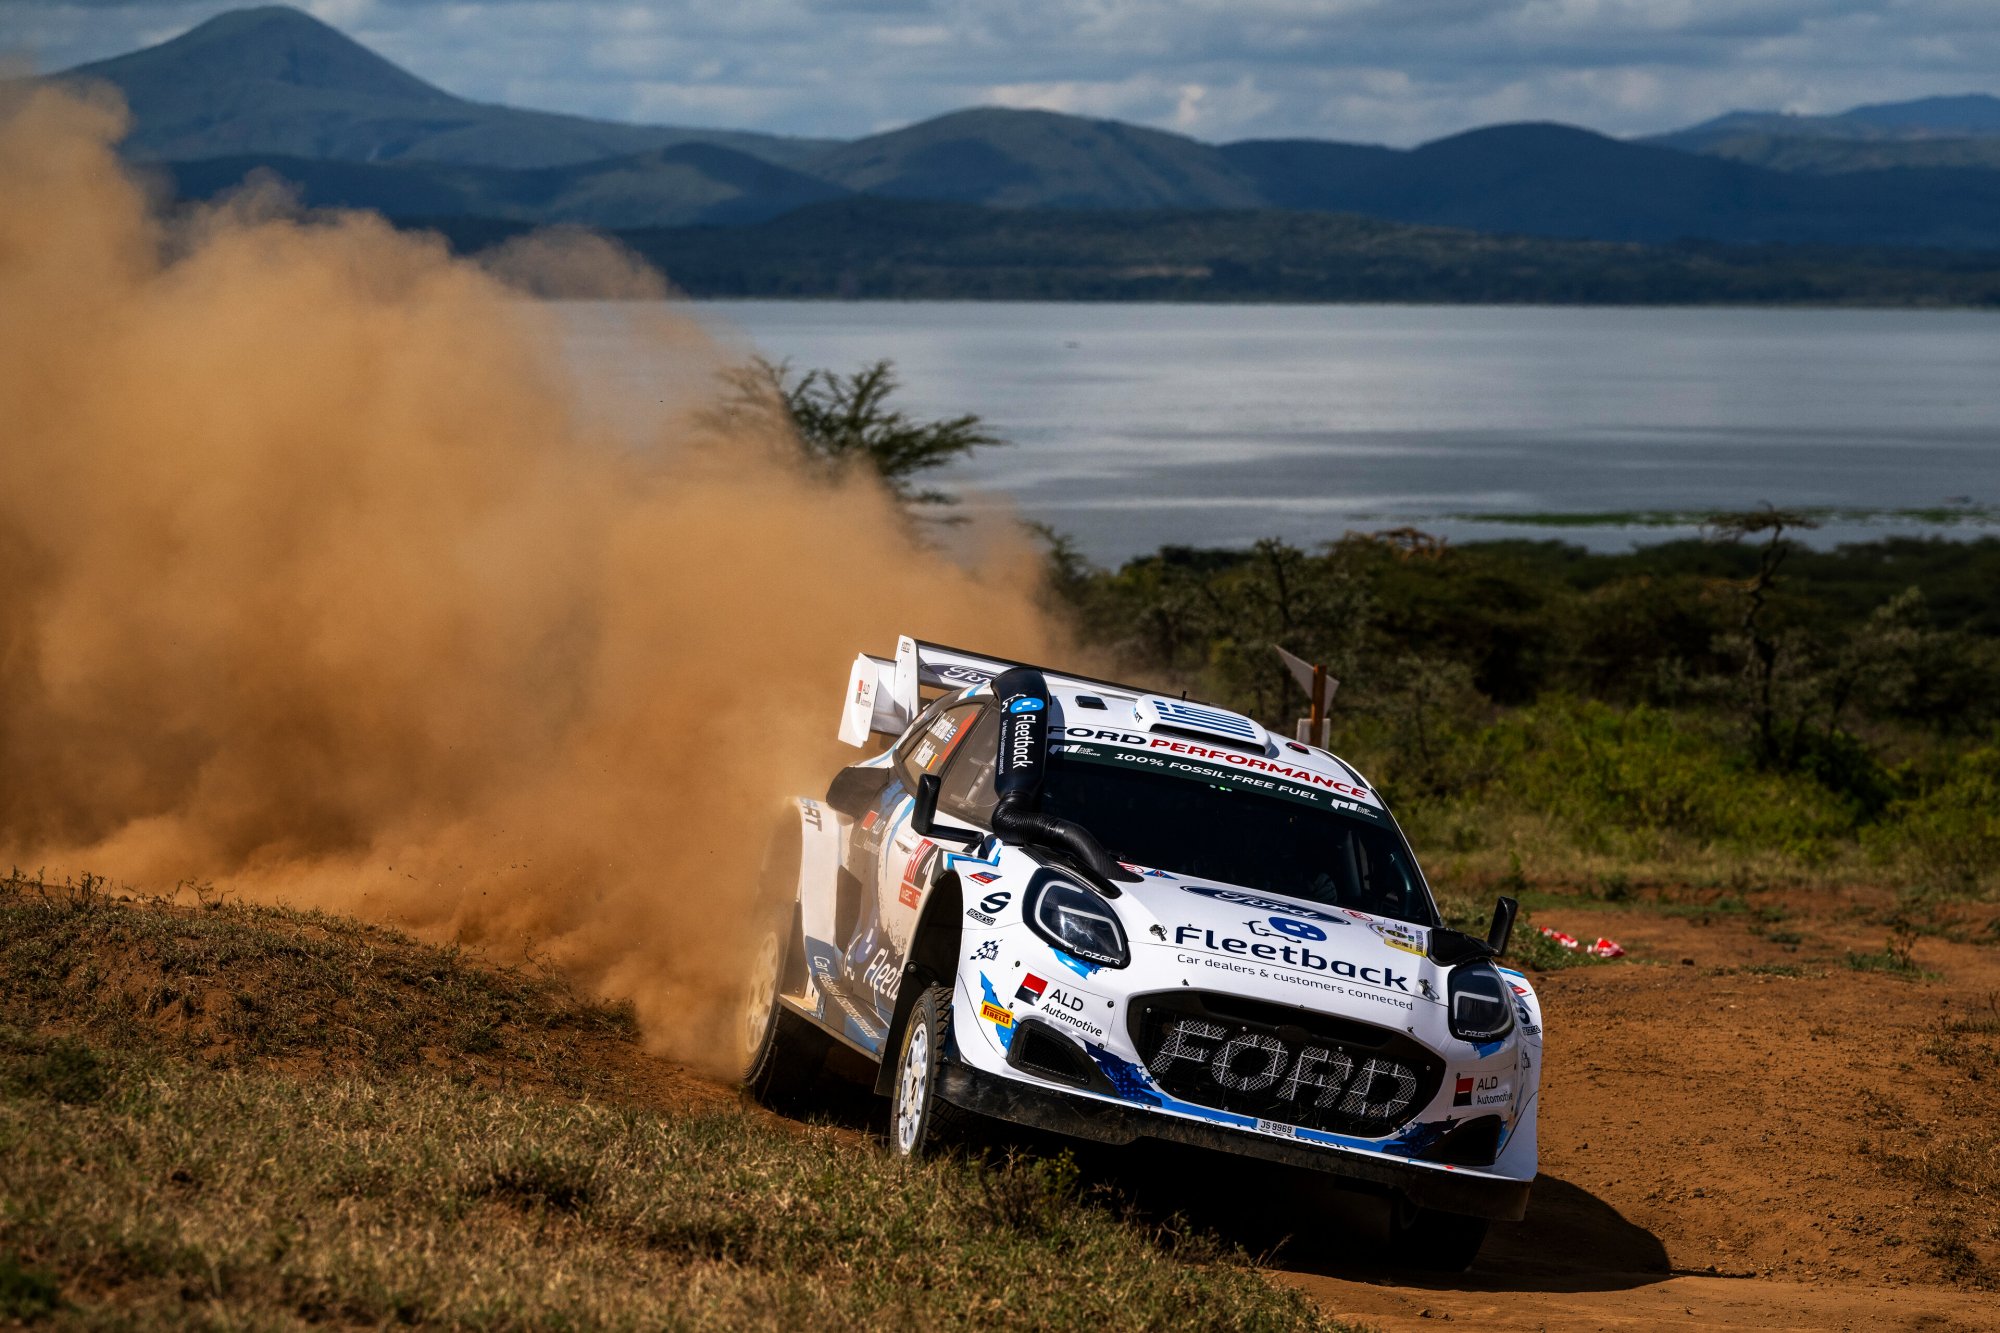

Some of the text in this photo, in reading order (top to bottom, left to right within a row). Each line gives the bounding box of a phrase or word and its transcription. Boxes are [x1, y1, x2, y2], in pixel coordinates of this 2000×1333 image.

[1012, 714, 1036, 769] Fleetback
[1047, 726, 1367, 799] FORD PERFORMANCE
[1114, 753, 1319, 801] 100% FOSSIL-FREE FUEL
[1214, 891, 1319, 919] Ford
[1175, 926, 1410, 992] Fleetback
[1177, 953, 1413, 1011] Car dealers & customers connected
[983, 1004, 1011, 1025] PIRELLI
[1048, 988, 1084, 1012] ALD
[1041, 1003, 1103, 1037] Automotive
[1149, 1019, 1417, 1118] FORD
[1476, 1076, 1499, 1092] ALD
[1476, 1090, 1513, 1105] Automotive
[1260, 1120, 1293, 1134] JS 9969
